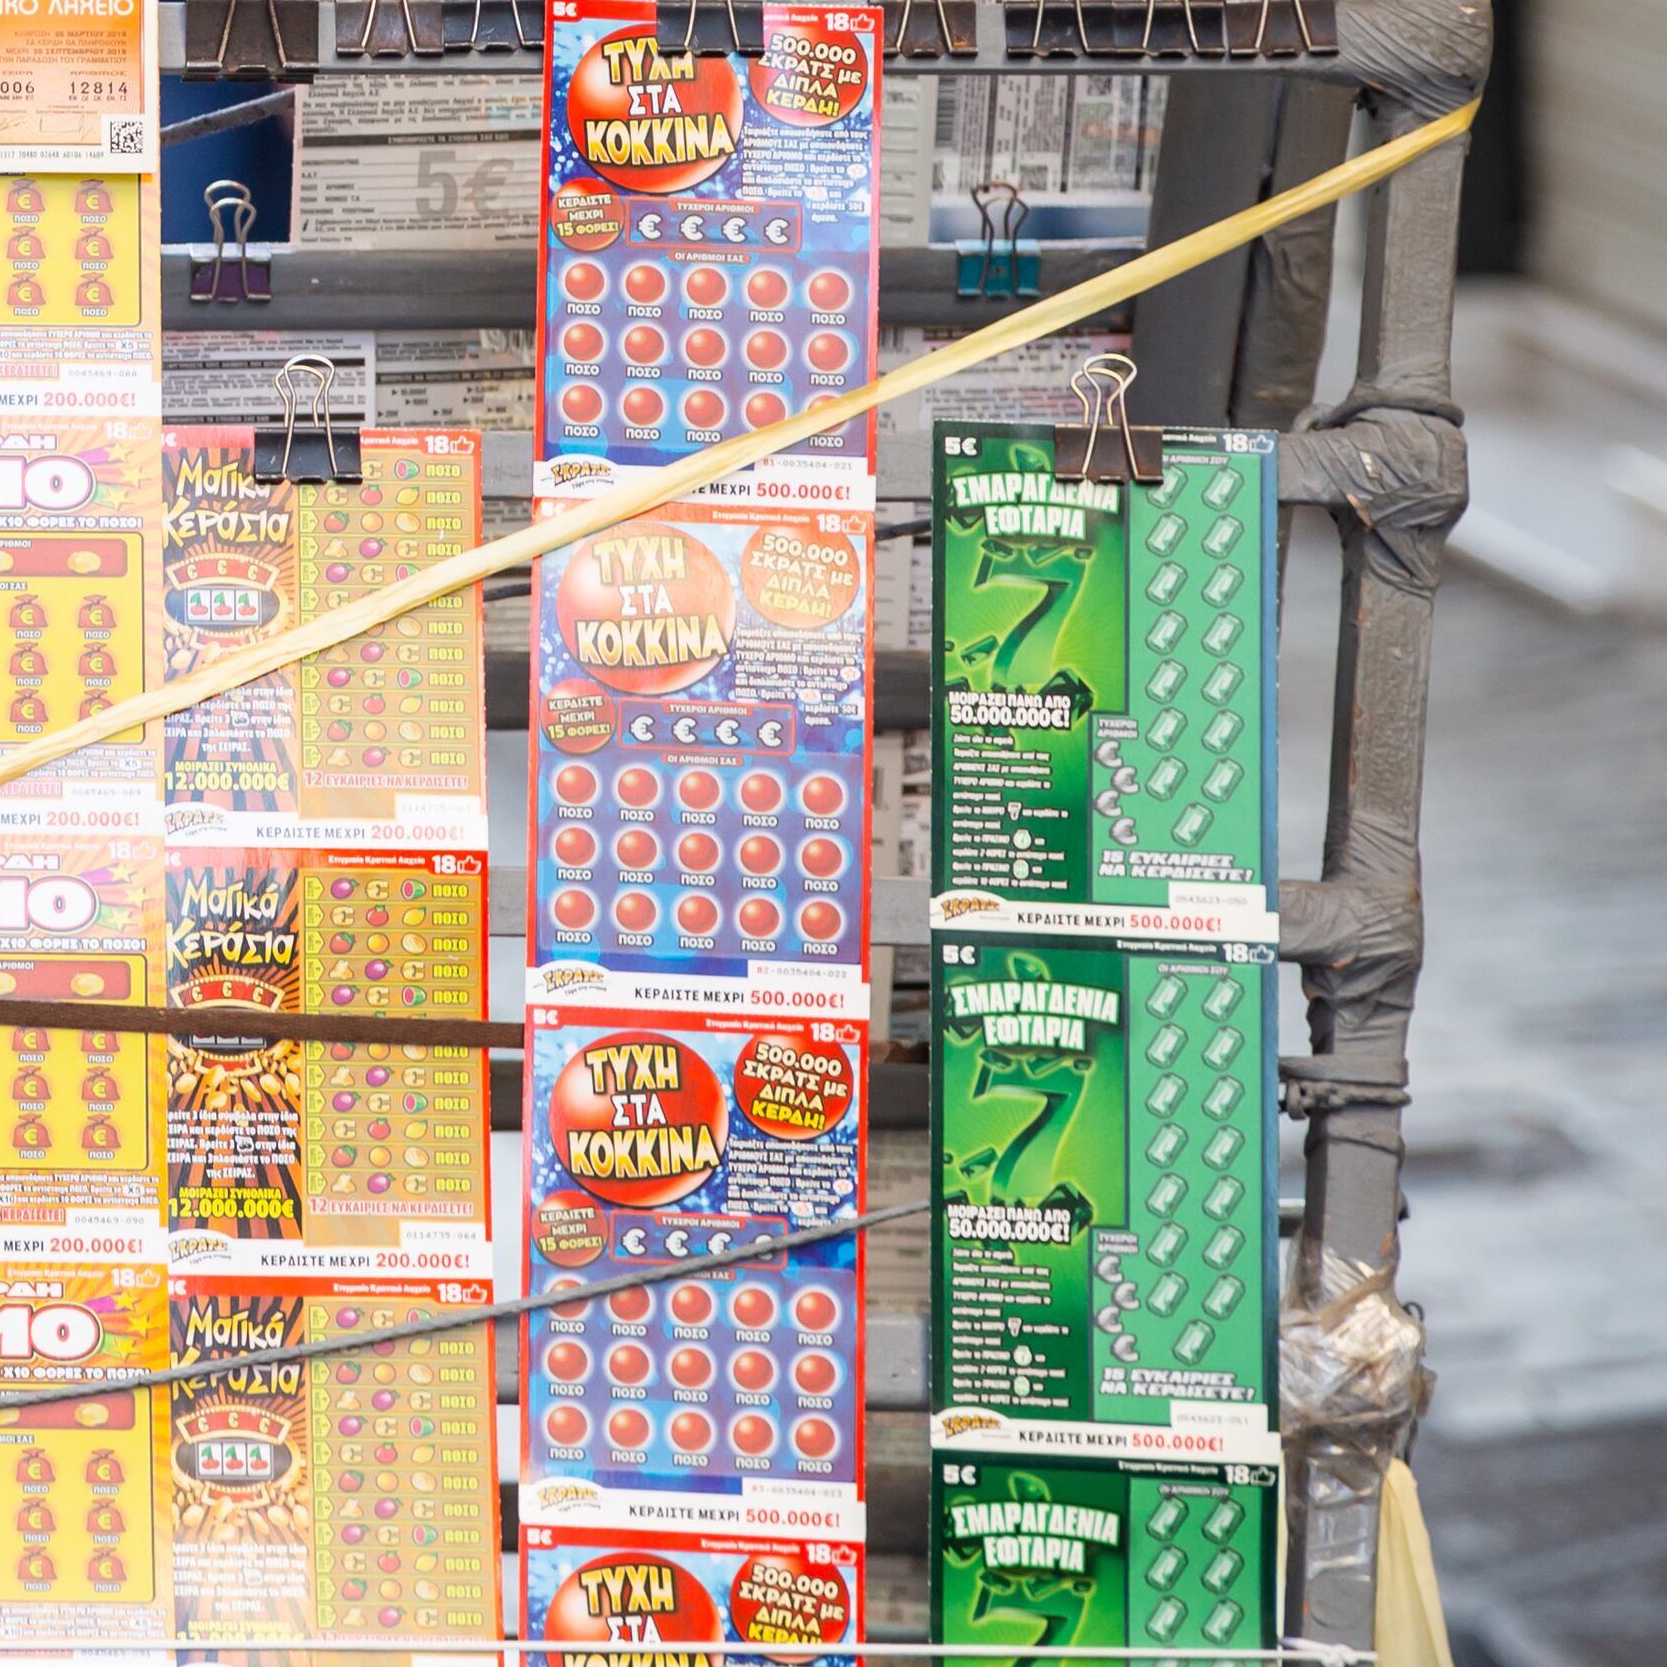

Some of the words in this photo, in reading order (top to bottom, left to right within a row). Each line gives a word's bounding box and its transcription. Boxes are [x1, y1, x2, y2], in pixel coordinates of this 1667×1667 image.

[0, 82, 35, 95] 006
[69, 81, 128, 95] 12814
[945, 437, 976, 456] 5€
[950, 707, 1070, 730] 50.000.000€!
[1018, 911, 1079, 928] ΚΕΡΔΙΣΤΕ
[1085, 914, 1125, 929] ΜΕΧΡΙ
[1130, 913, 1221, 933] 500.000€!
[635, 988, 700, 1002] ΚΕΡΔΙΣΤΕ
[704, 991, 744, 1004] ΜΕΧΡΙ
[751, 990, 844, 1008] 500.000€!
[953, 981, 1120, 1025] ΣΜΑΡΑΓΔΕΝΙΑ
[533, 1009, 558, 1025] 5€
[585, 1043, 681, 1093] ΤΥΧΗ
[756, 1042, 842, 1076] 500.000
[743, 1059, 820, 1092] ΣΚΡΑΤΣ
[824, 1080, 848, 1098] με
[759, 1084, 824, 1111] ΔΙΠΛΑ
[611, 1093, 667, 1127] ΣΤΑ
[752, 1100, 825, 1130] ΚΕΡΔΗ!
[568, 1125, 720, 1179] ΚΟΚΚΙΝΑ
[168, 1198, 294, 1219] 12.000.000€
[539, 1207, 595, 1224] ΚΕΡΔΙΣΤΕ
[552, 1223, 587, 1235] ΜΕΧΡΙ
[3, 1240, 44, 1252] ΜΕΧΡΙ
[50, 1237, 143, 1254] 200.000€!
[540, 1236, 557, 1251] 15
[559, 1237, 603, 1250] ΦΟΡΕΣ!
[261, 1254, 325, 1267] ΚΕΡΔΙΣΤΕ
[330, 1255, 370, 1267] ΜΕΧΡΙ
[376, 1253, 469, 1270] 200.000€!
